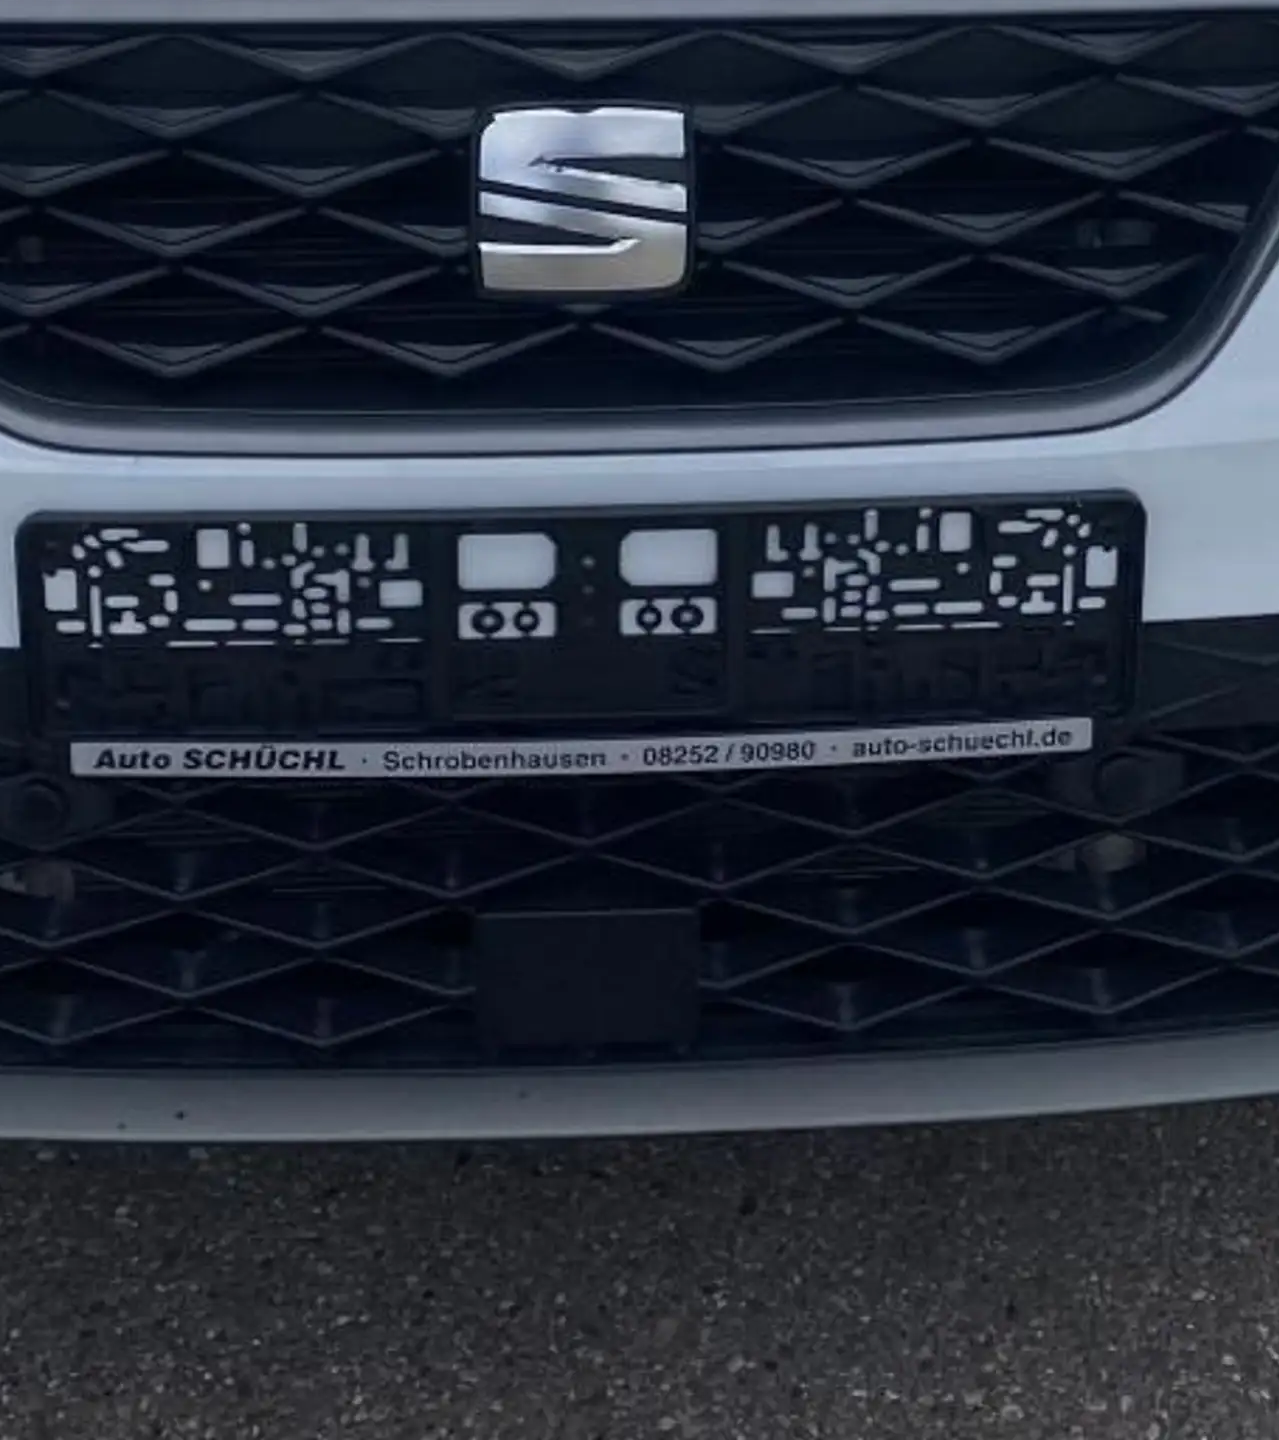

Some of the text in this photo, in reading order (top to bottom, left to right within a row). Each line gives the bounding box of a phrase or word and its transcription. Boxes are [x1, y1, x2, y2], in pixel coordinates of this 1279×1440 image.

[92, 748, 172, 771] Auto
[181, 743, 346, 772] SCHÜCHL
[382, 746, 607, 772] Schrobenhausen
[851, 726, 1073, 759] auto-schuechl.de
